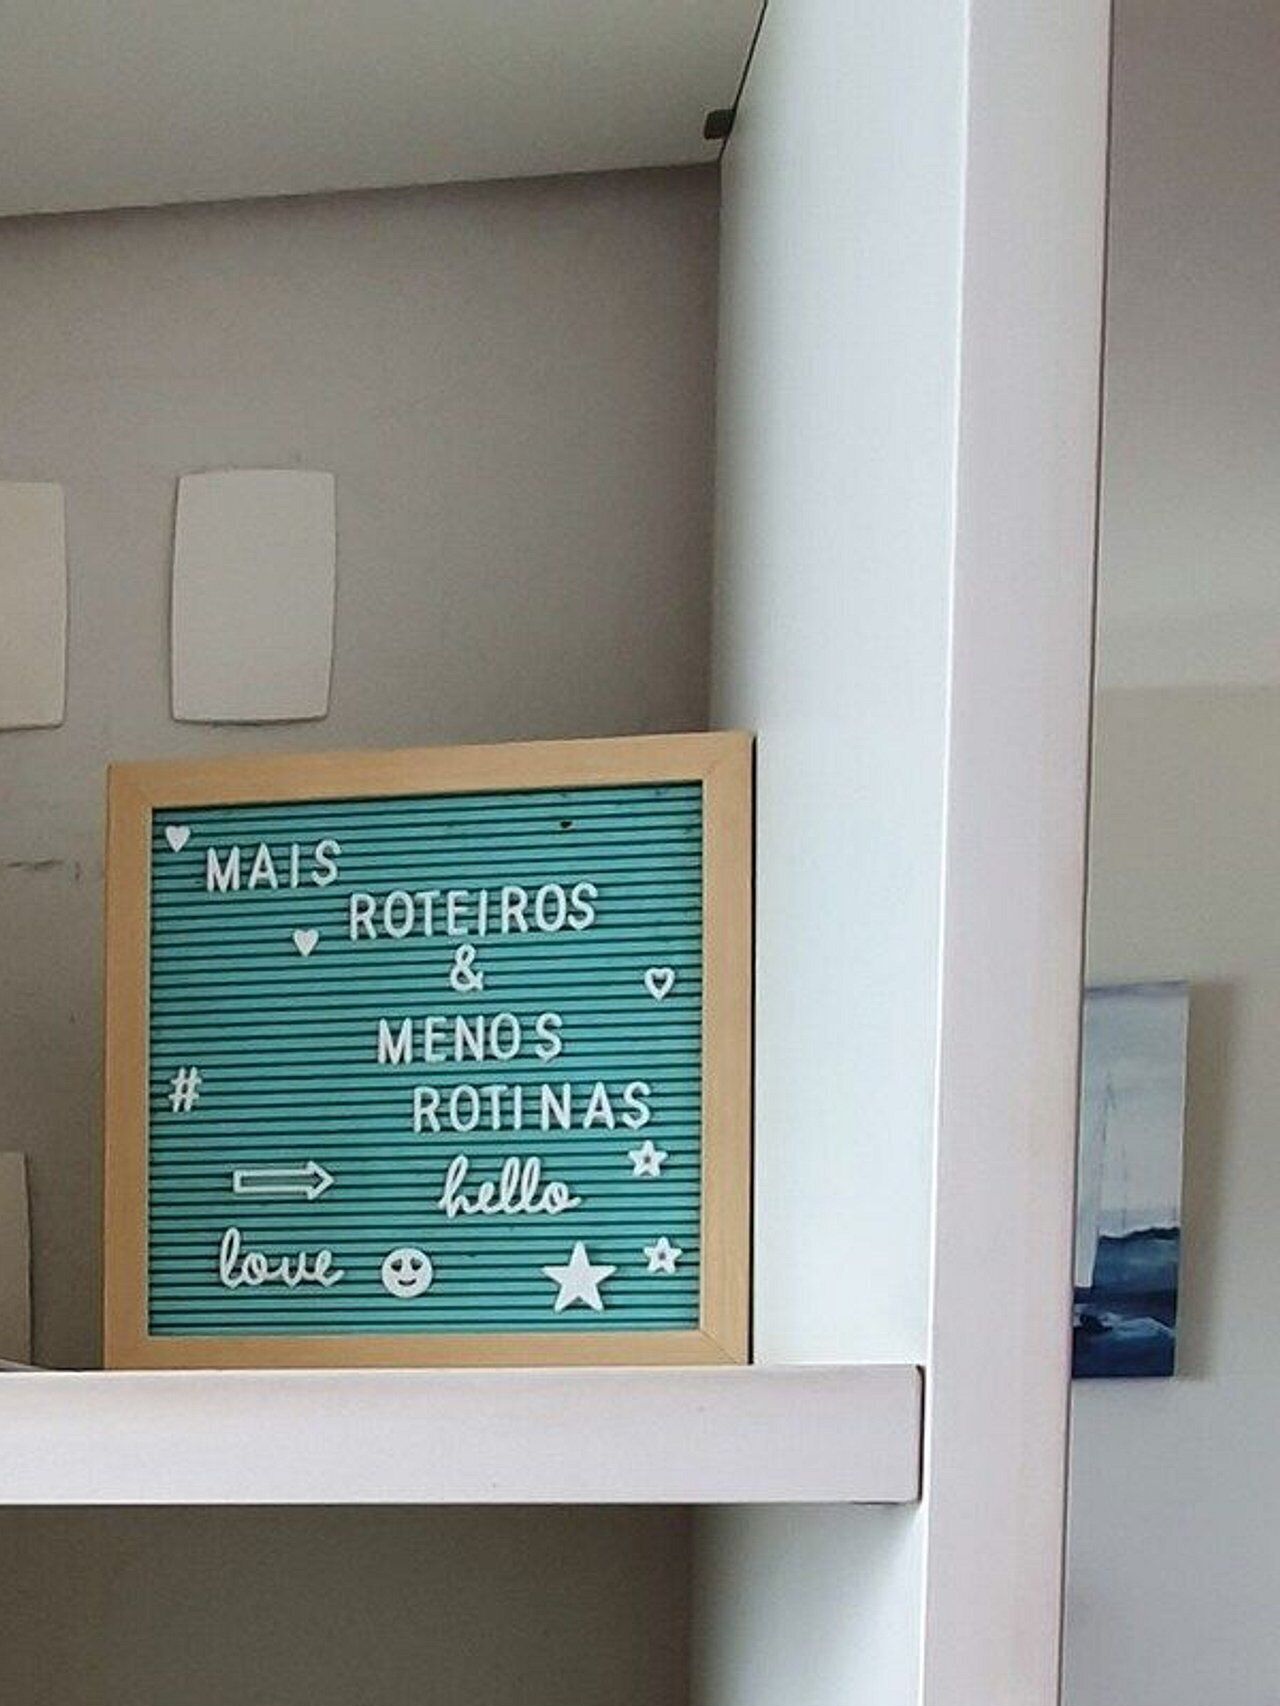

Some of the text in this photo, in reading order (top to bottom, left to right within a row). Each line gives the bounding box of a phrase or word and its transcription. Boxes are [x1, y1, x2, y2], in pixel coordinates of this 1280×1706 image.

[205, 839, 342, 892] MAIS
[348, 882, 599, 940] ROTEIROS
[449, 943, 485, 992] &
[376, 1012, 563, 1065] MENOS
[413, 1081, 652, 1134] ROTINAS
[438, 1154, 581, 1218] hello
[220, 1226, 345, 1289] love
